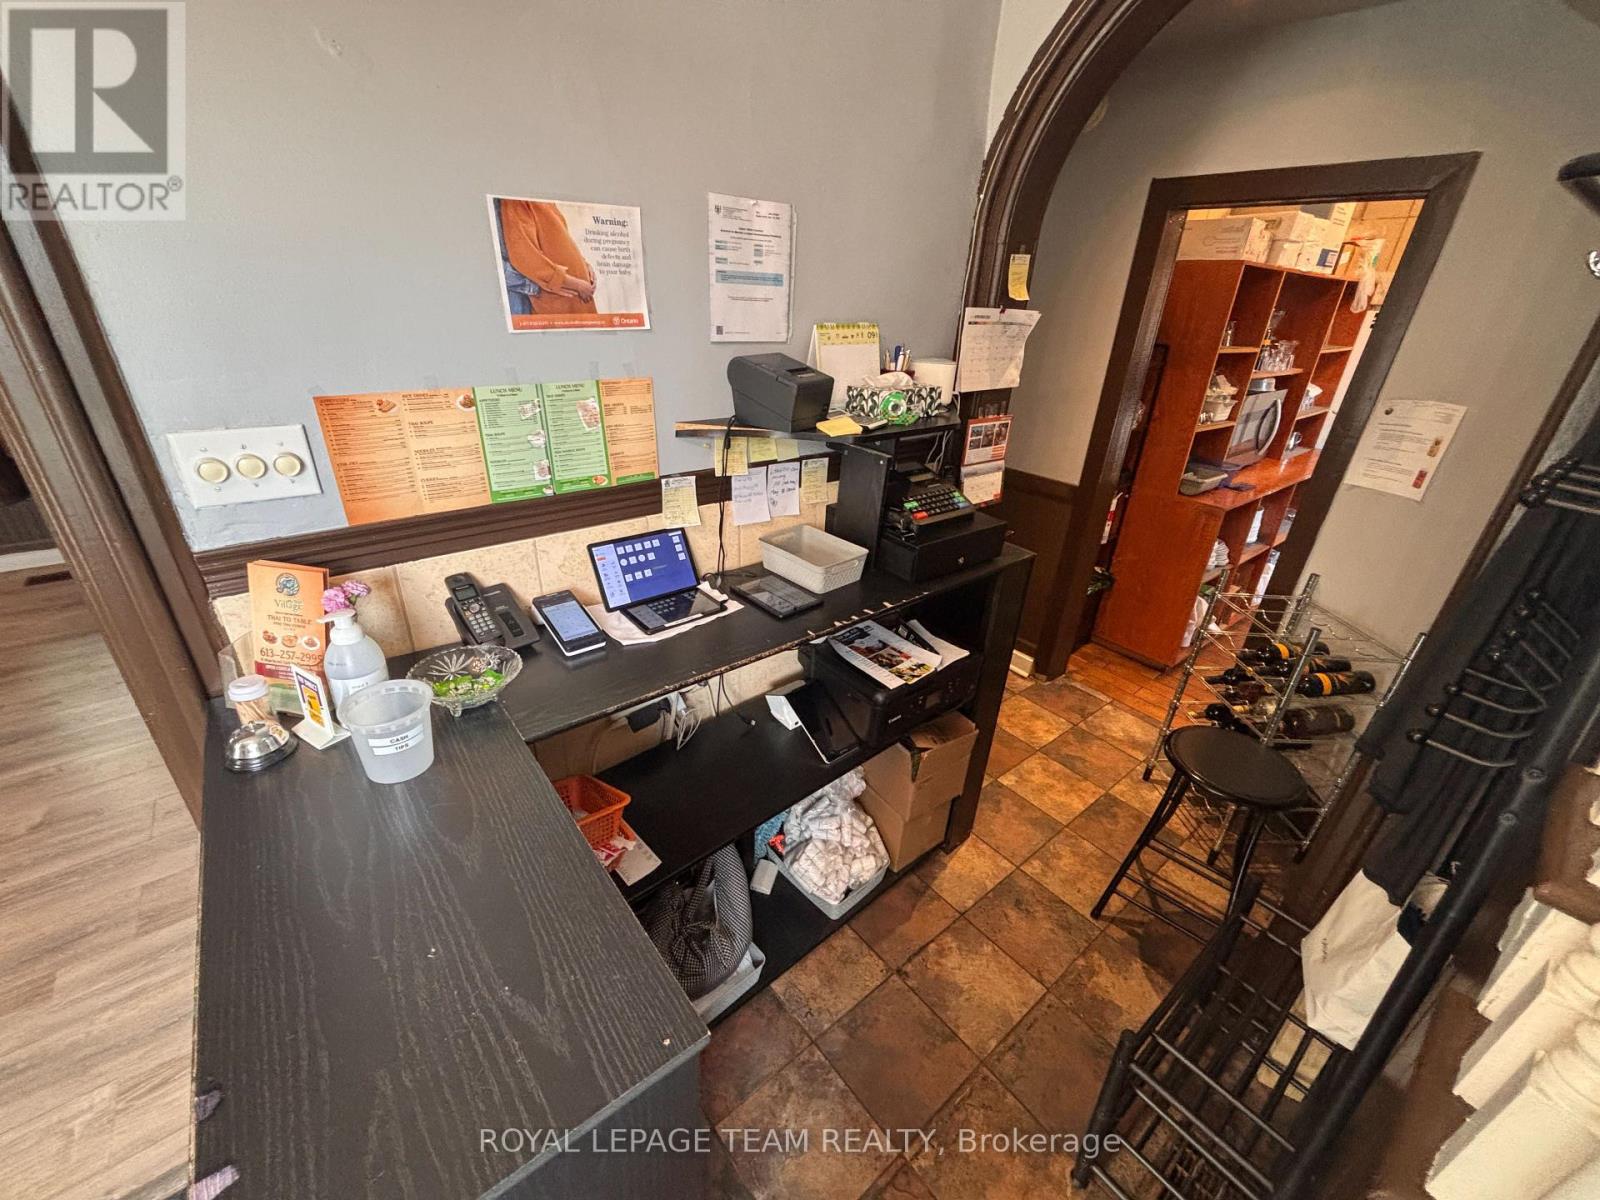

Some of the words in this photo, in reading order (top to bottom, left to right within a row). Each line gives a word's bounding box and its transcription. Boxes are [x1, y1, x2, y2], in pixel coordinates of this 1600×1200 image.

[592, 215, 629, 228] Warning:
[267, 614, 281, 622] THAI
[389, 733, 409, 744] CASH
[395, 743, 409, 751] TIPS
